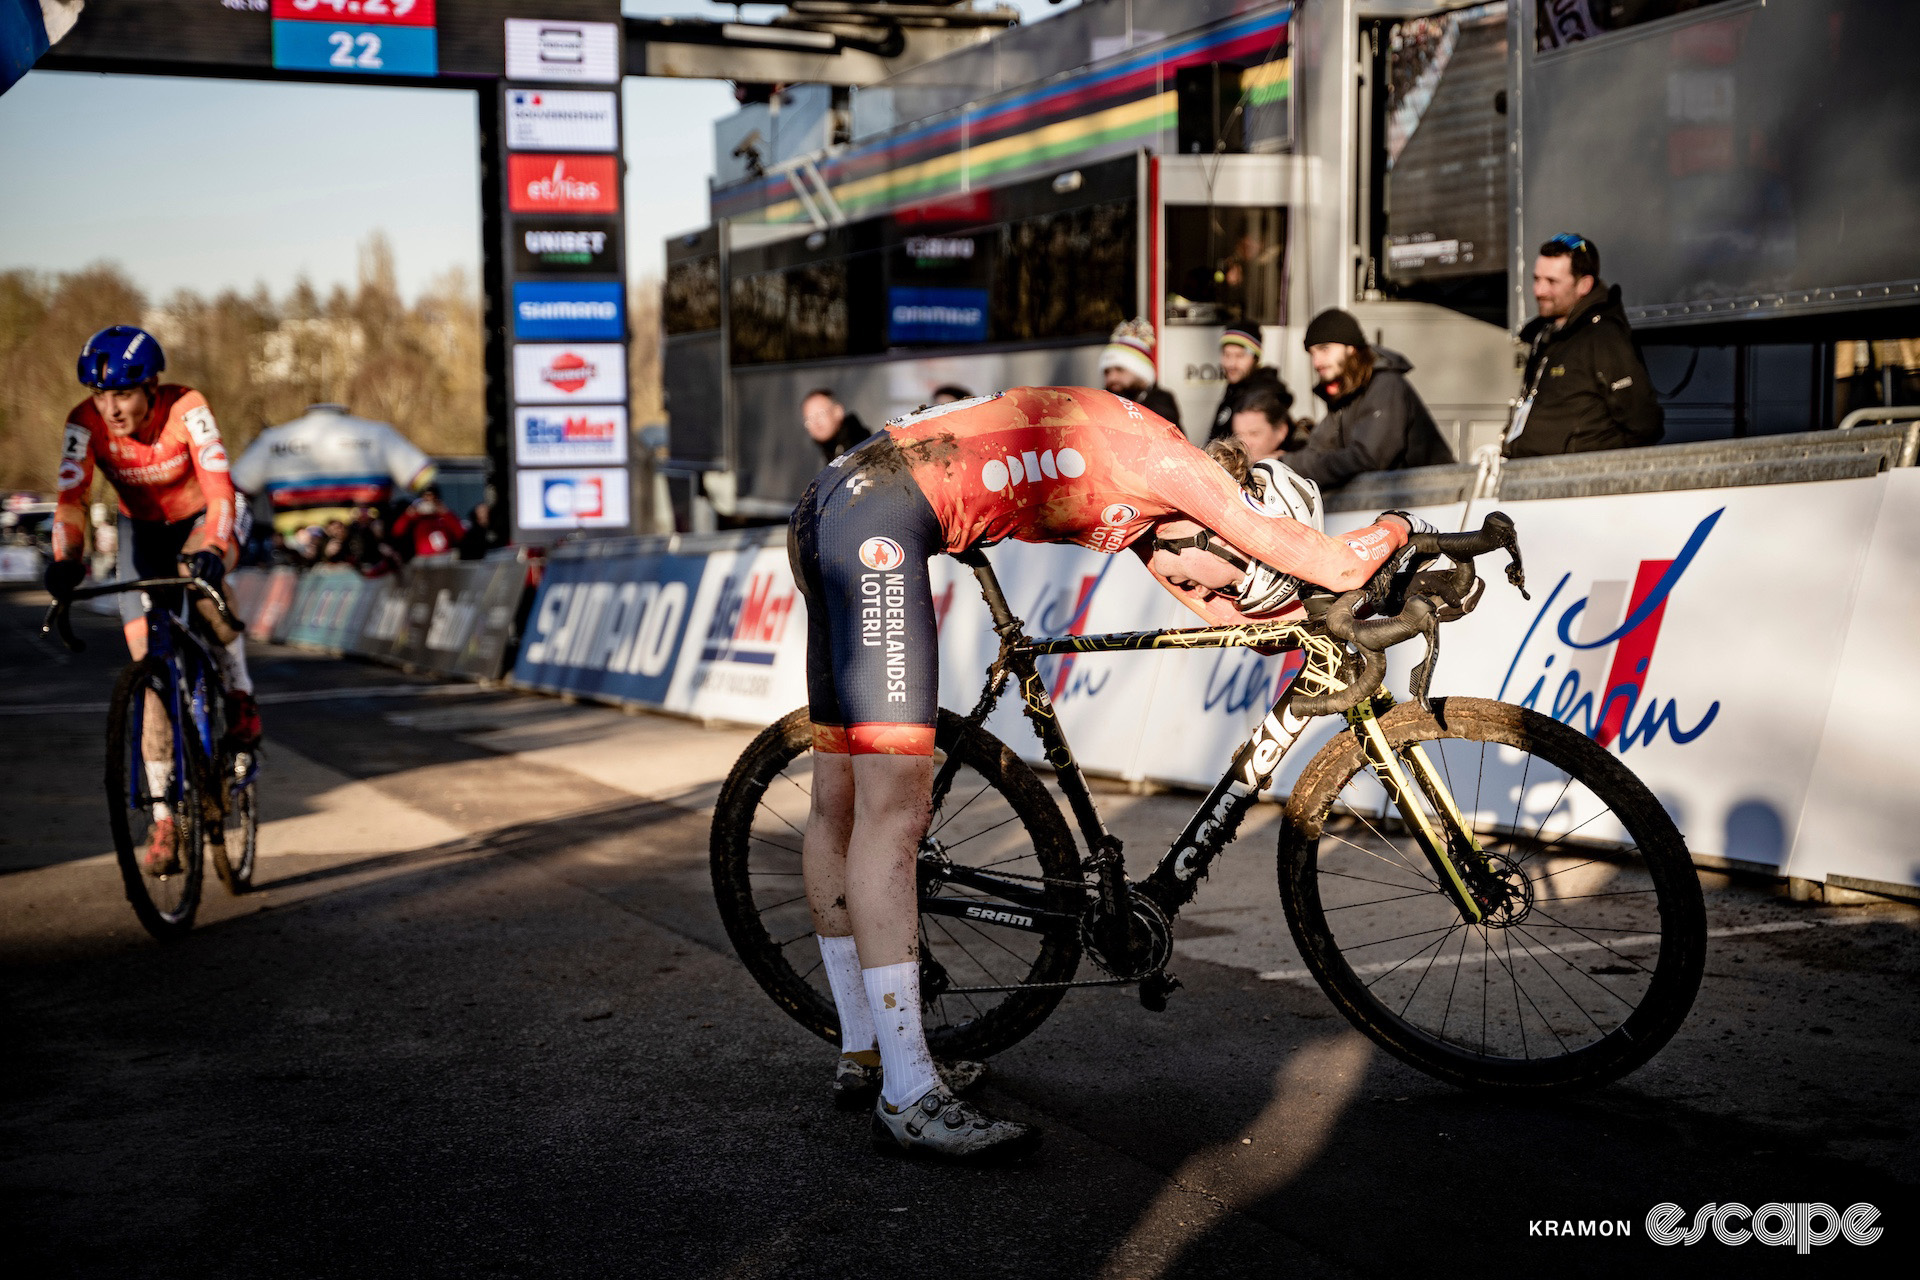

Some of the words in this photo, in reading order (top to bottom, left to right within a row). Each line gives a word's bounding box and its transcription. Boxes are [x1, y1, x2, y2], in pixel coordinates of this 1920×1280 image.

[328, 31, 384, 69] 22
[525, 231, 606, 253] UNIBET
[197, 420, 210, 433] 2
[67, 435, 78, 453] 2
[860, 573, 882, 647] LOTERIJ
[885, 573, 907, 703] NEDERLANDSE
[966, 906, 1034, 928] SRAM
